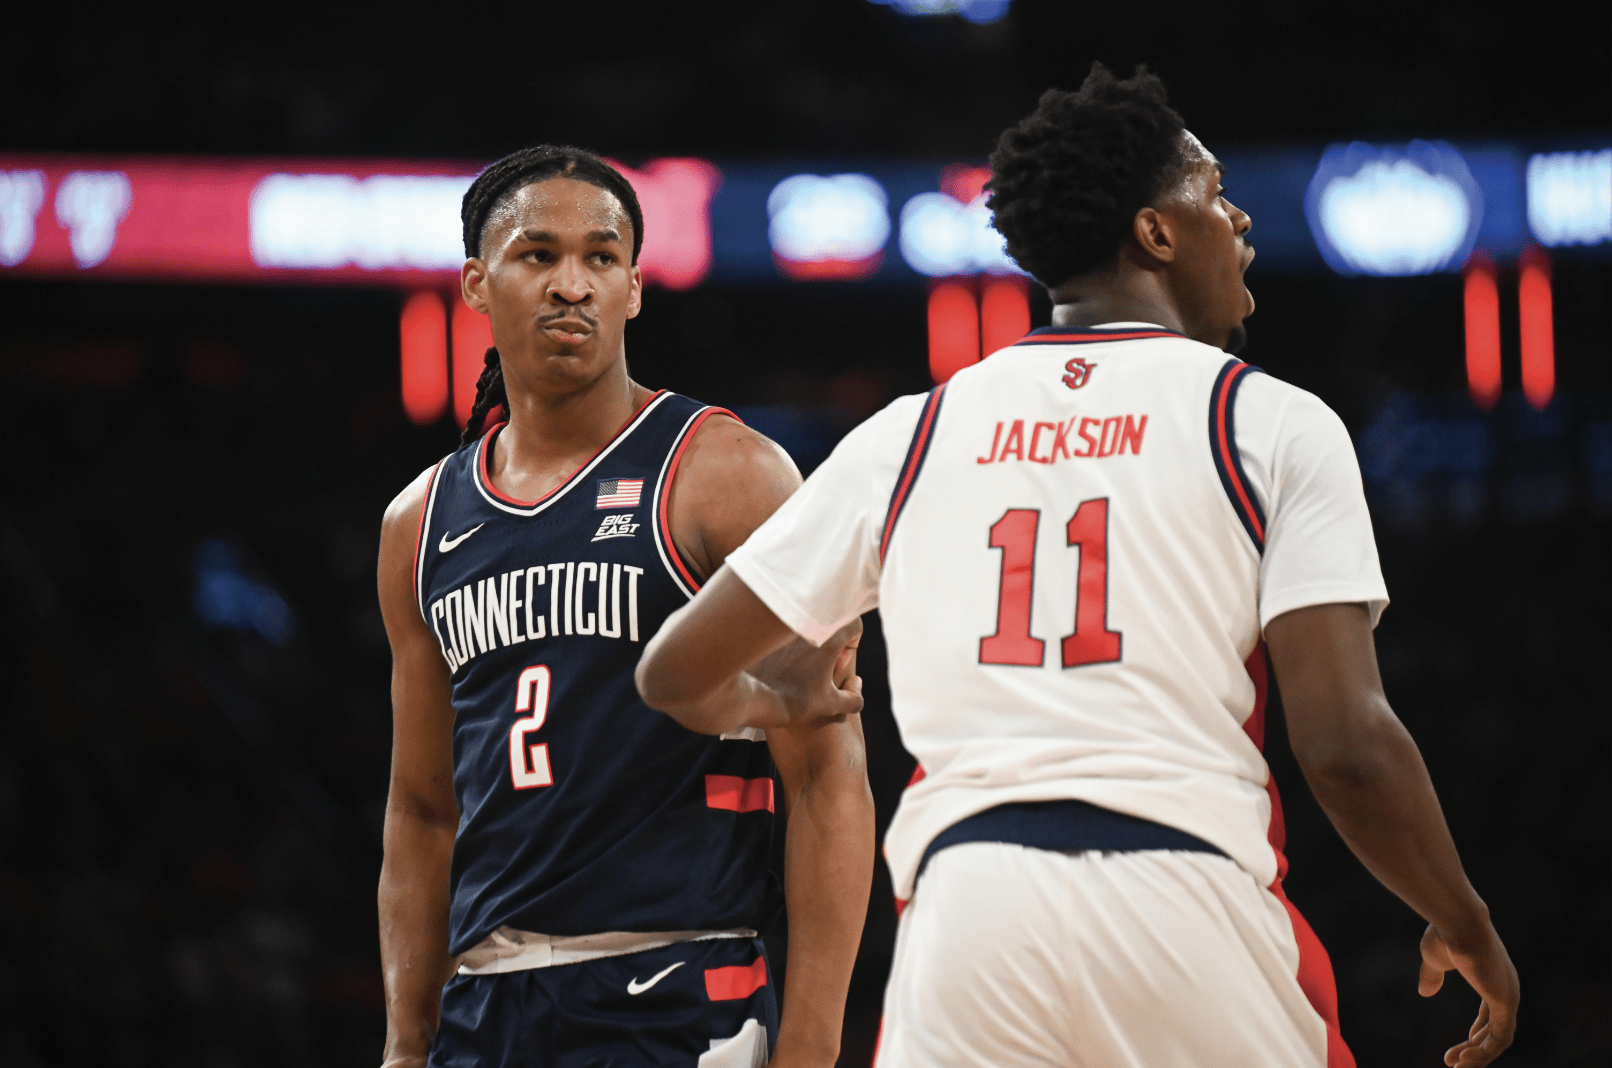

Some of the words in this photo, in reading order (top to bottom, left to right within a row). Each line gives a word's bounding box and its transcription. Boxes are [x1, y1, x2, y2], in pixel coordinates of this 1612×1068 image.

[977, 414, 1149, 464] JACKSON
[594, 523, 640, 537] EAST
[600, 513, 635, 526] BIG
[430, 561, 644, 675] CONNECTICUT
[978, 497, 1123, 670] 11
[509, 664, 554, 790] 2
